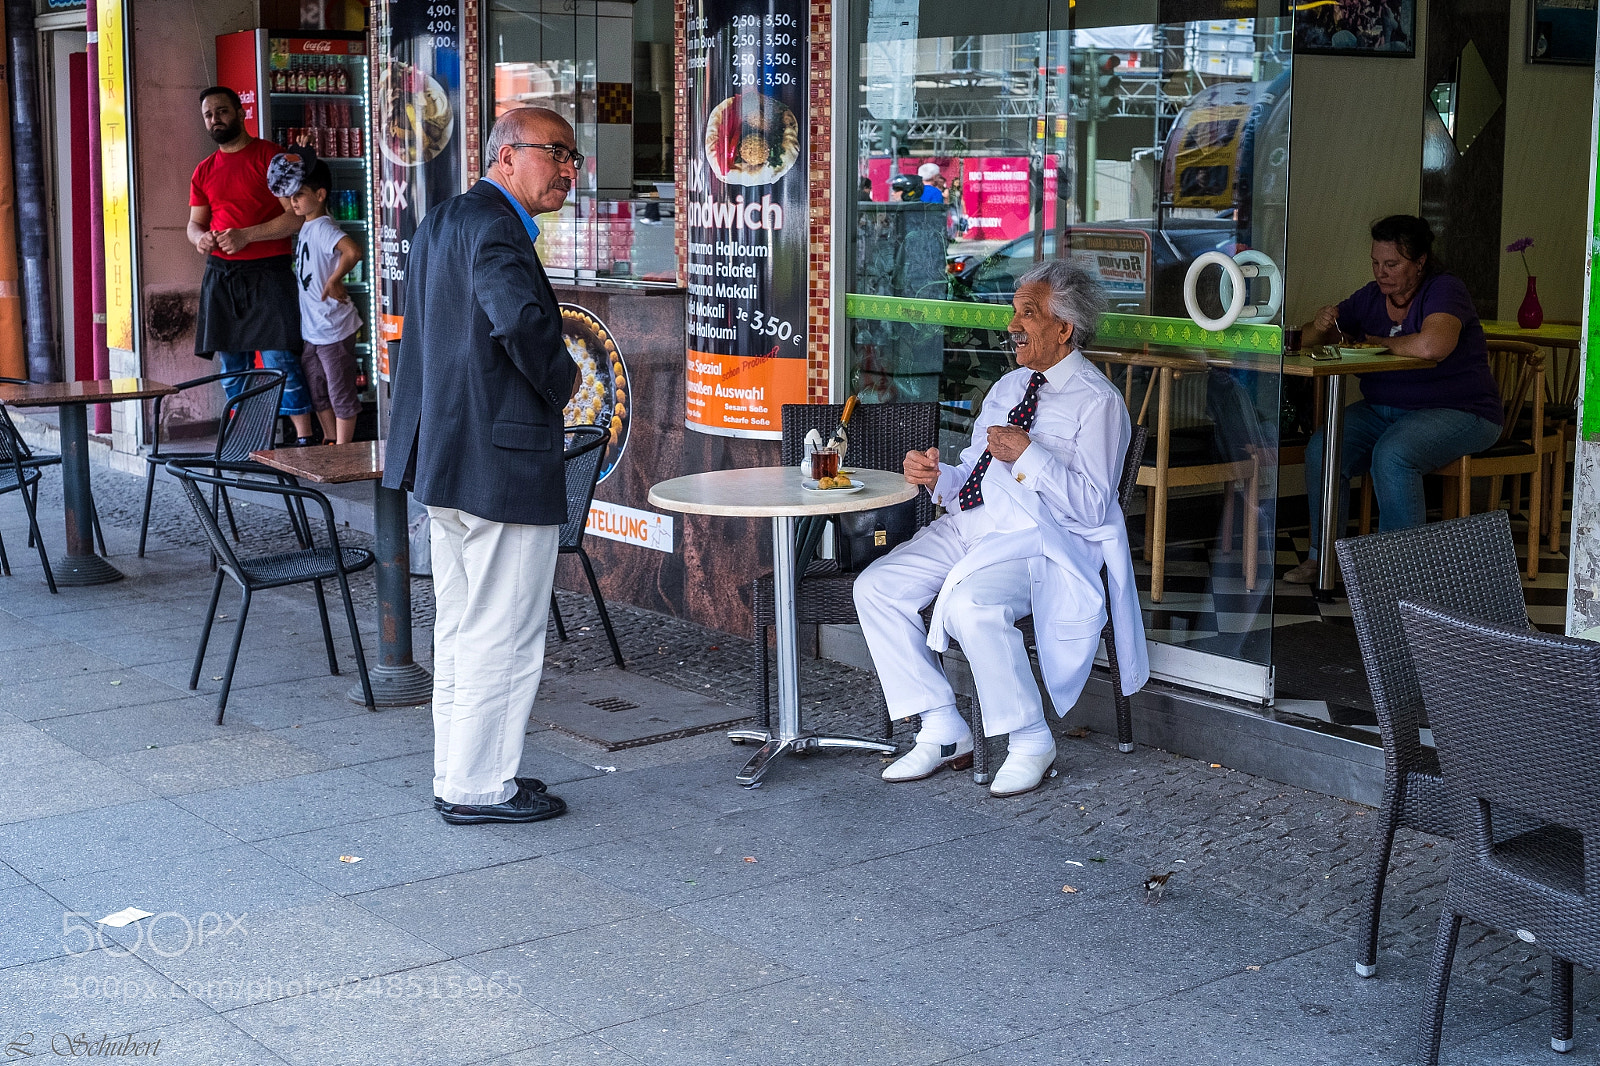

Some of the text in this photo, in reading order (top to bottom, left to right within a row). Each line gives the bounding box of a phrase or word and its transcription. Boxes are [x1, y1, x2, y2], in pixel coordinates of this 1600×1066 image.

[105, 0, 116, 98] GNER
[701, 35, 715, 49] Brot
[688, 194, 784, 231] andwich
[715, 241, 772, 258] Halloumi
[715, 262, 756, 278] Falafel
[715, 283, 757, 300] Makali
[696, 301, 725, 319] Makali
[696, 321, 737, 340] Halloumi
[696, 359, 722, 376] Spezial
[715, 383, 764, 401] Auswahl
[724, 403, 747, 412] Sesam
[723, 415, 749, 425] Scharfe
